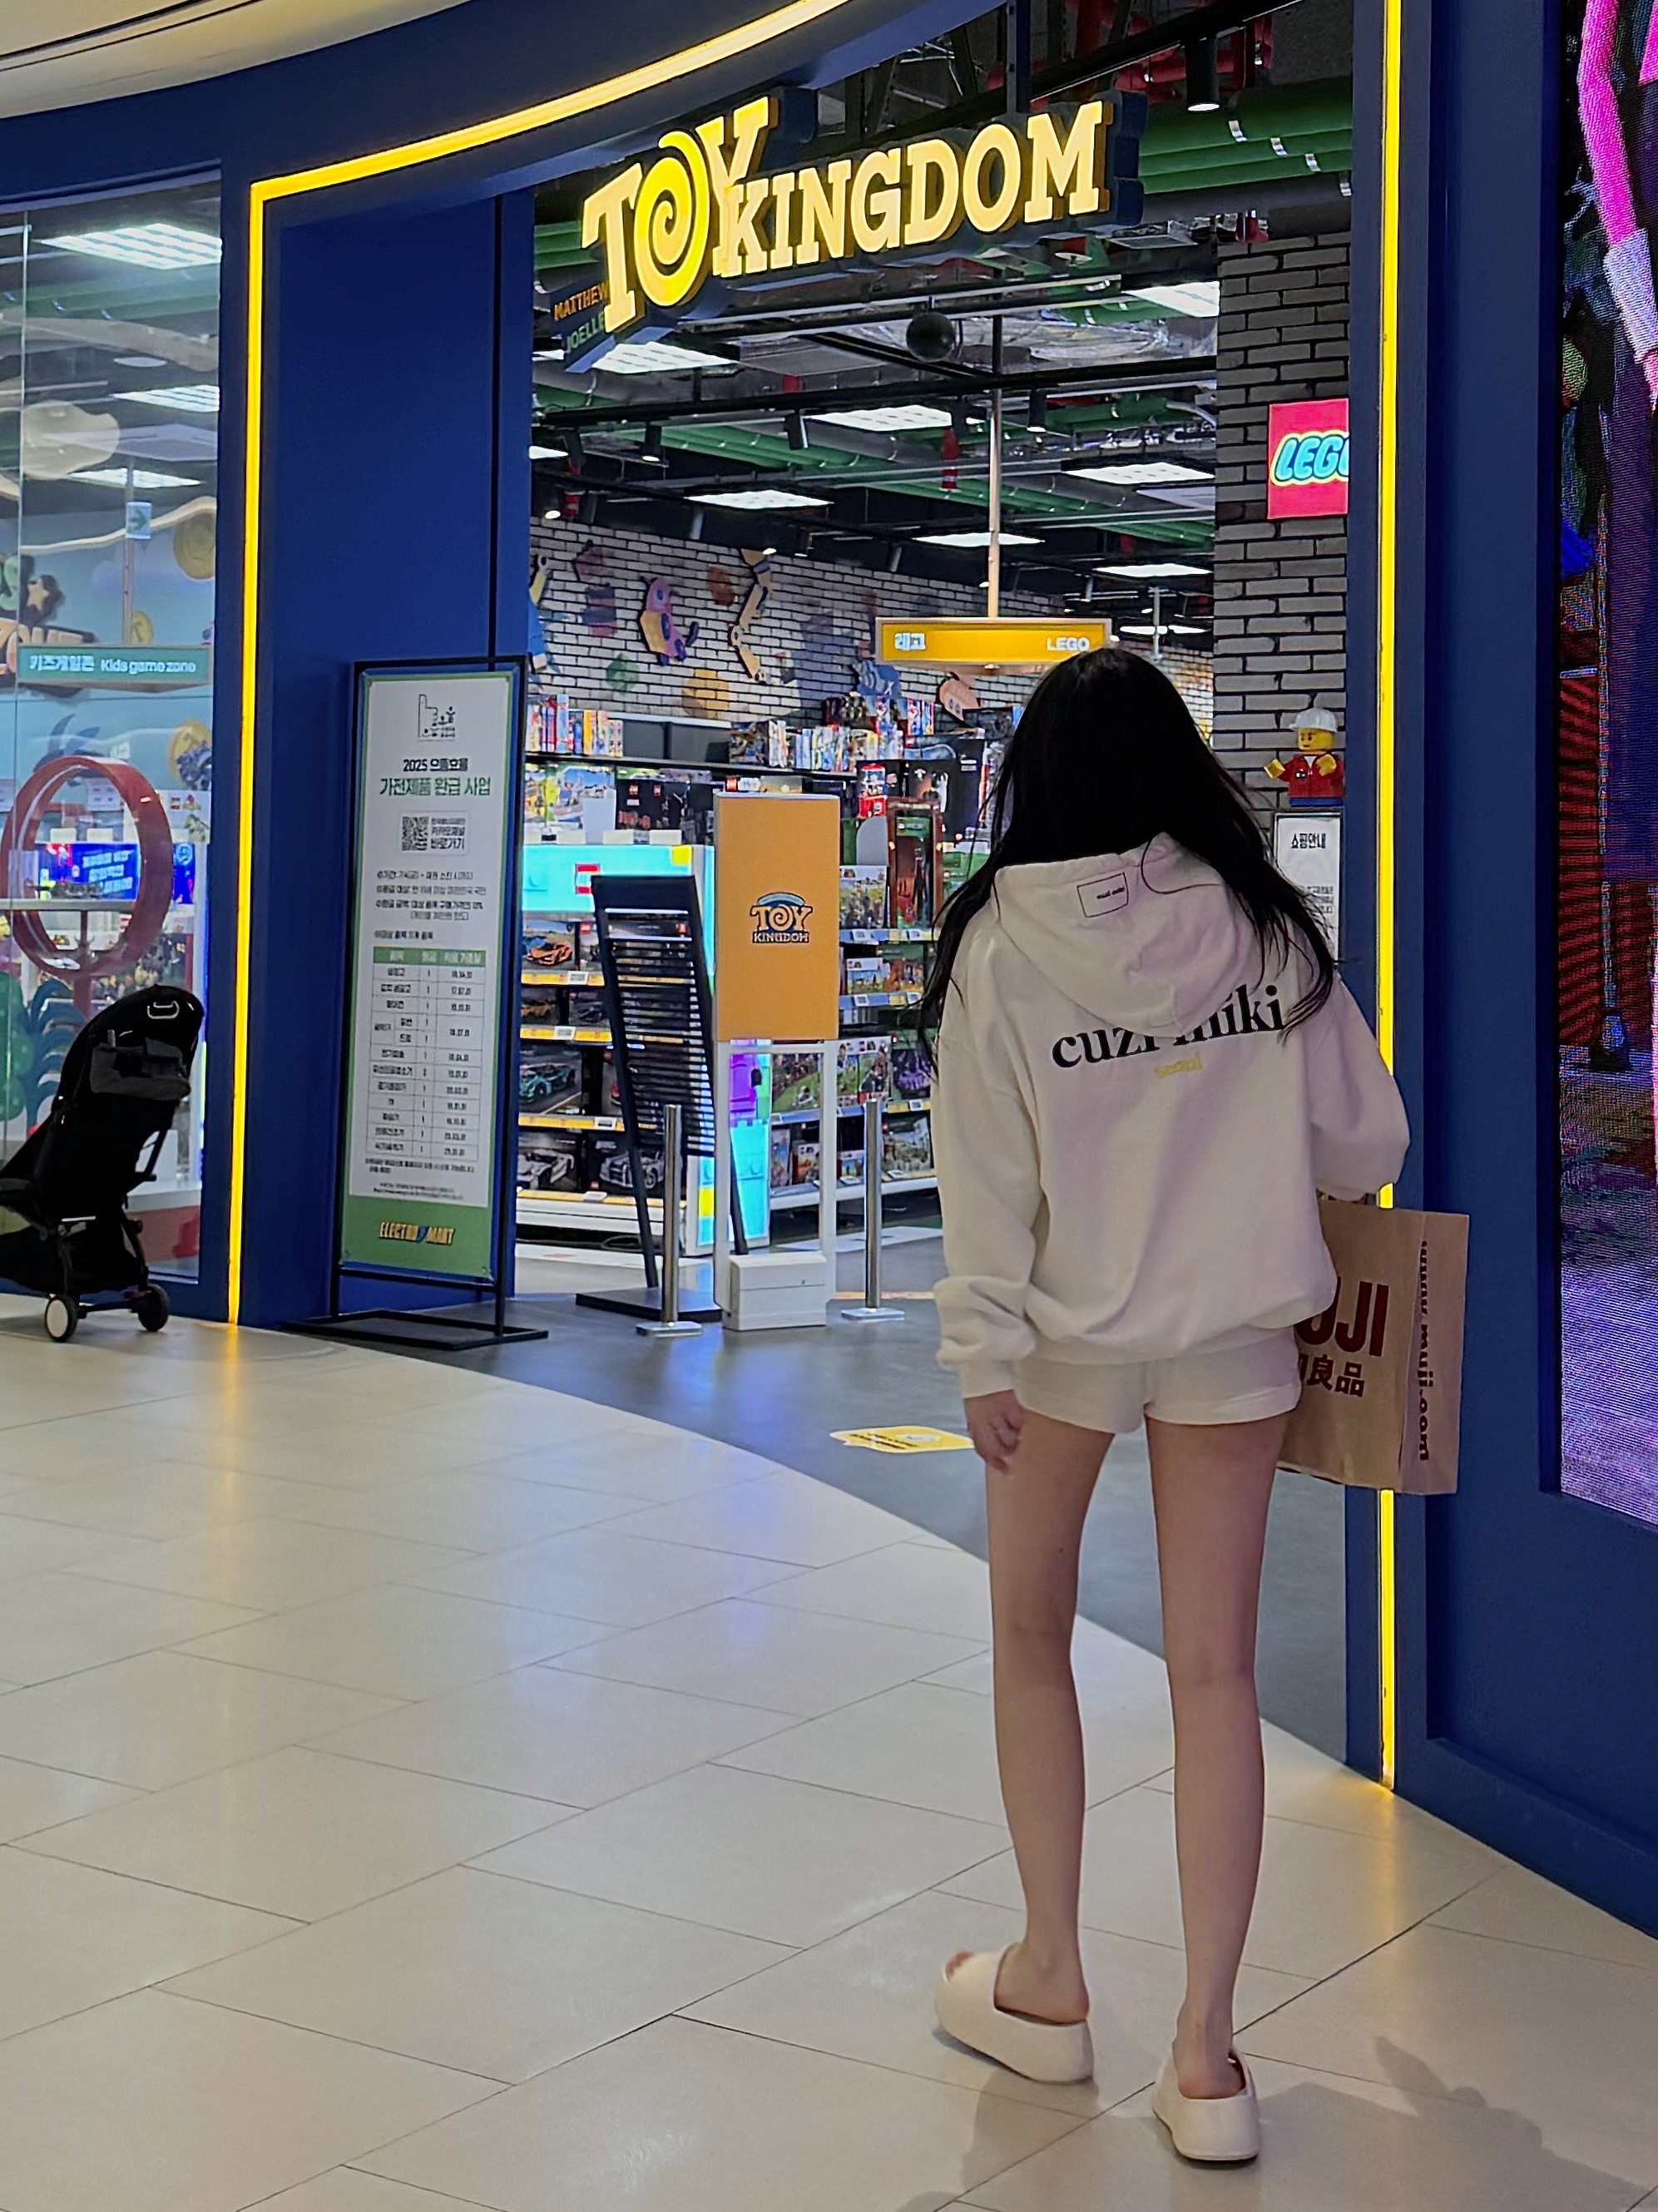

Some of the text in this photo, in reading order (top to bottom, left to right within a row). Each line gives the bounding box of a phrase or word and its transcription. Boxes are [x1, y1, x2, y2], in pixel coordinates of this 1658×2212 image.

[582, 96, 1105, 333] TOY KINGDOM
[894, 632, 926, 651] 레고
[1047, 637, 1091, 651] LEGO
[101, 659, 127, 672] Kids
[403, 759, 428, 772] 2025
[464, 777, 491, 796] 사업
[1291, 833, 1326, 849] 쇼핑안내
[750, 903, 814, 932] TOY
[753, 932, 809, 943] KINGDOM
[1294, 1275, 1390, 1357] UJI
